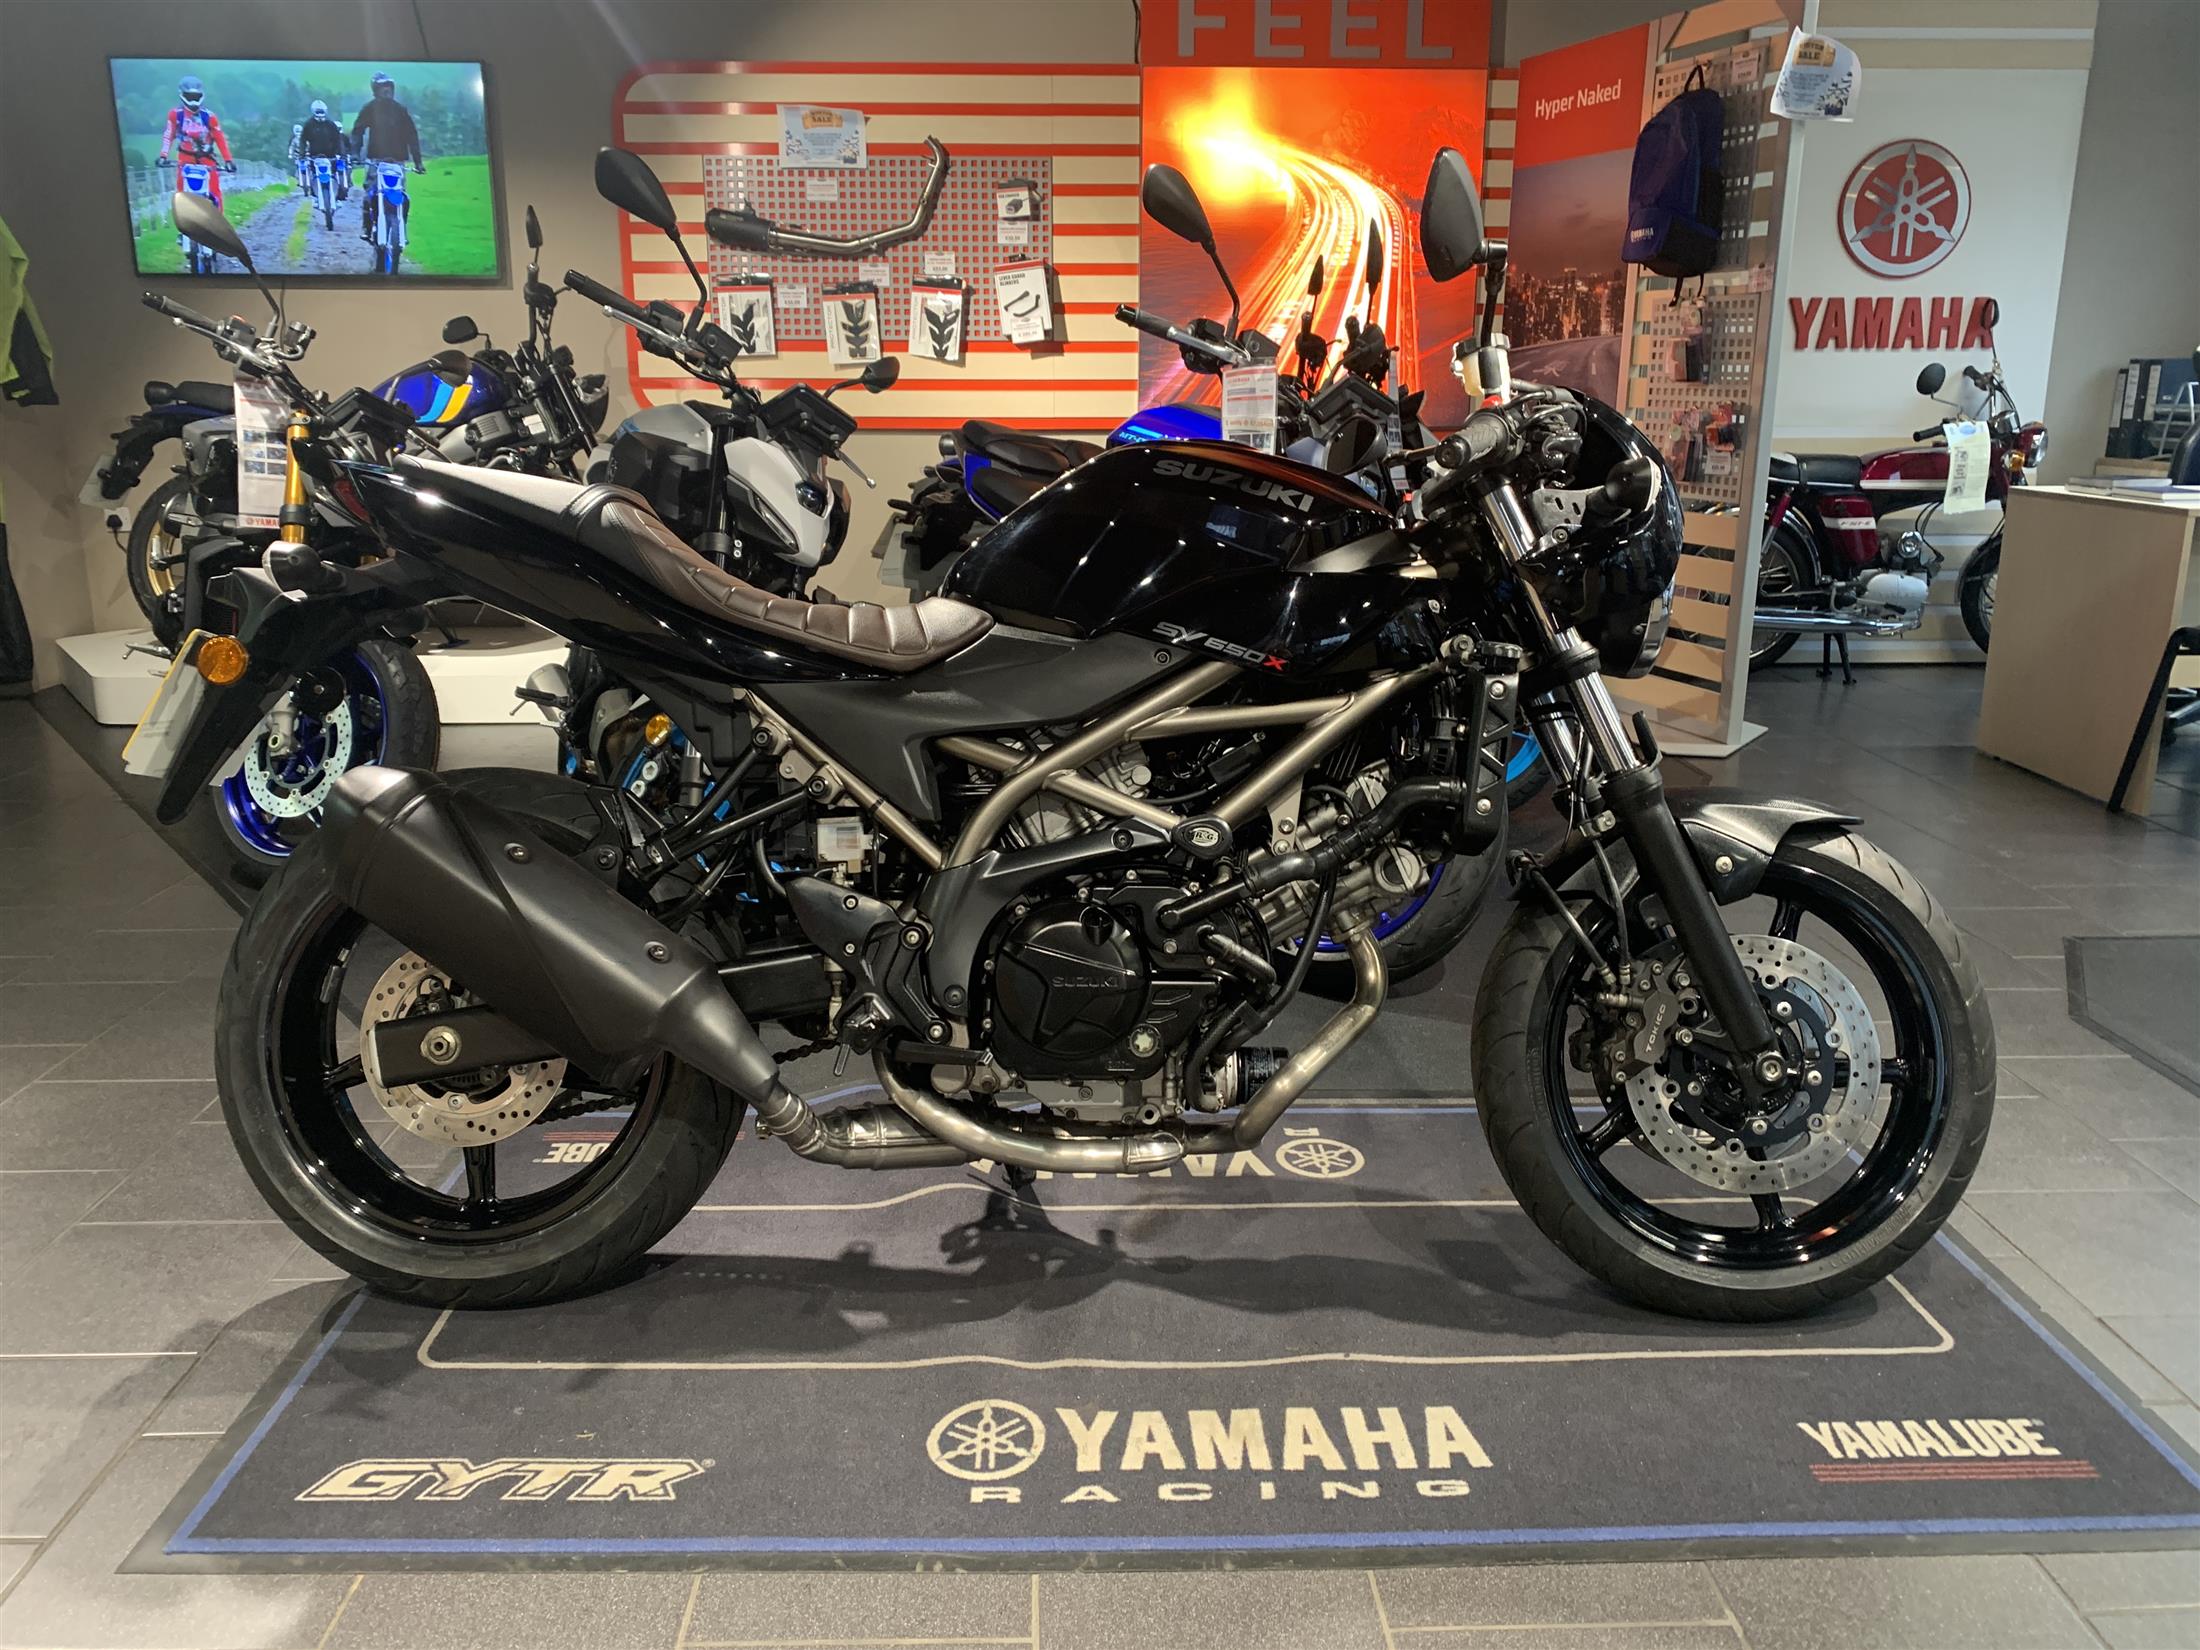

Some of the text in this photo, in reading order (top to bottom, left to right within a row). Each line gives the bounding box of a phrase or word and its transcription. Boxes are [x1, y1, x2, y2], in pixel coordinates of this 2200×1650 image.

[1178, 0, 1453, 58] FEEL
[1535, 79, 1622, 120] Hyper Naked
[1789, 297, 1994, 351] YAMAHA
[1152, 459, 1315, 512] SUZUKI
[256, 517, 280, 528] YAMA
[1052, 976, 1118, 987] SUZUKI
[1645, 1003, 1666, 1053] TOKICO
[1055, 1406, 1494, 1473] YAMAHA
[1796, 1418, 2062, 1460] YAMALUBE
[294, 1458, 705, 1501] GYTR
[969, 1479, 1471, 1503] RACING
